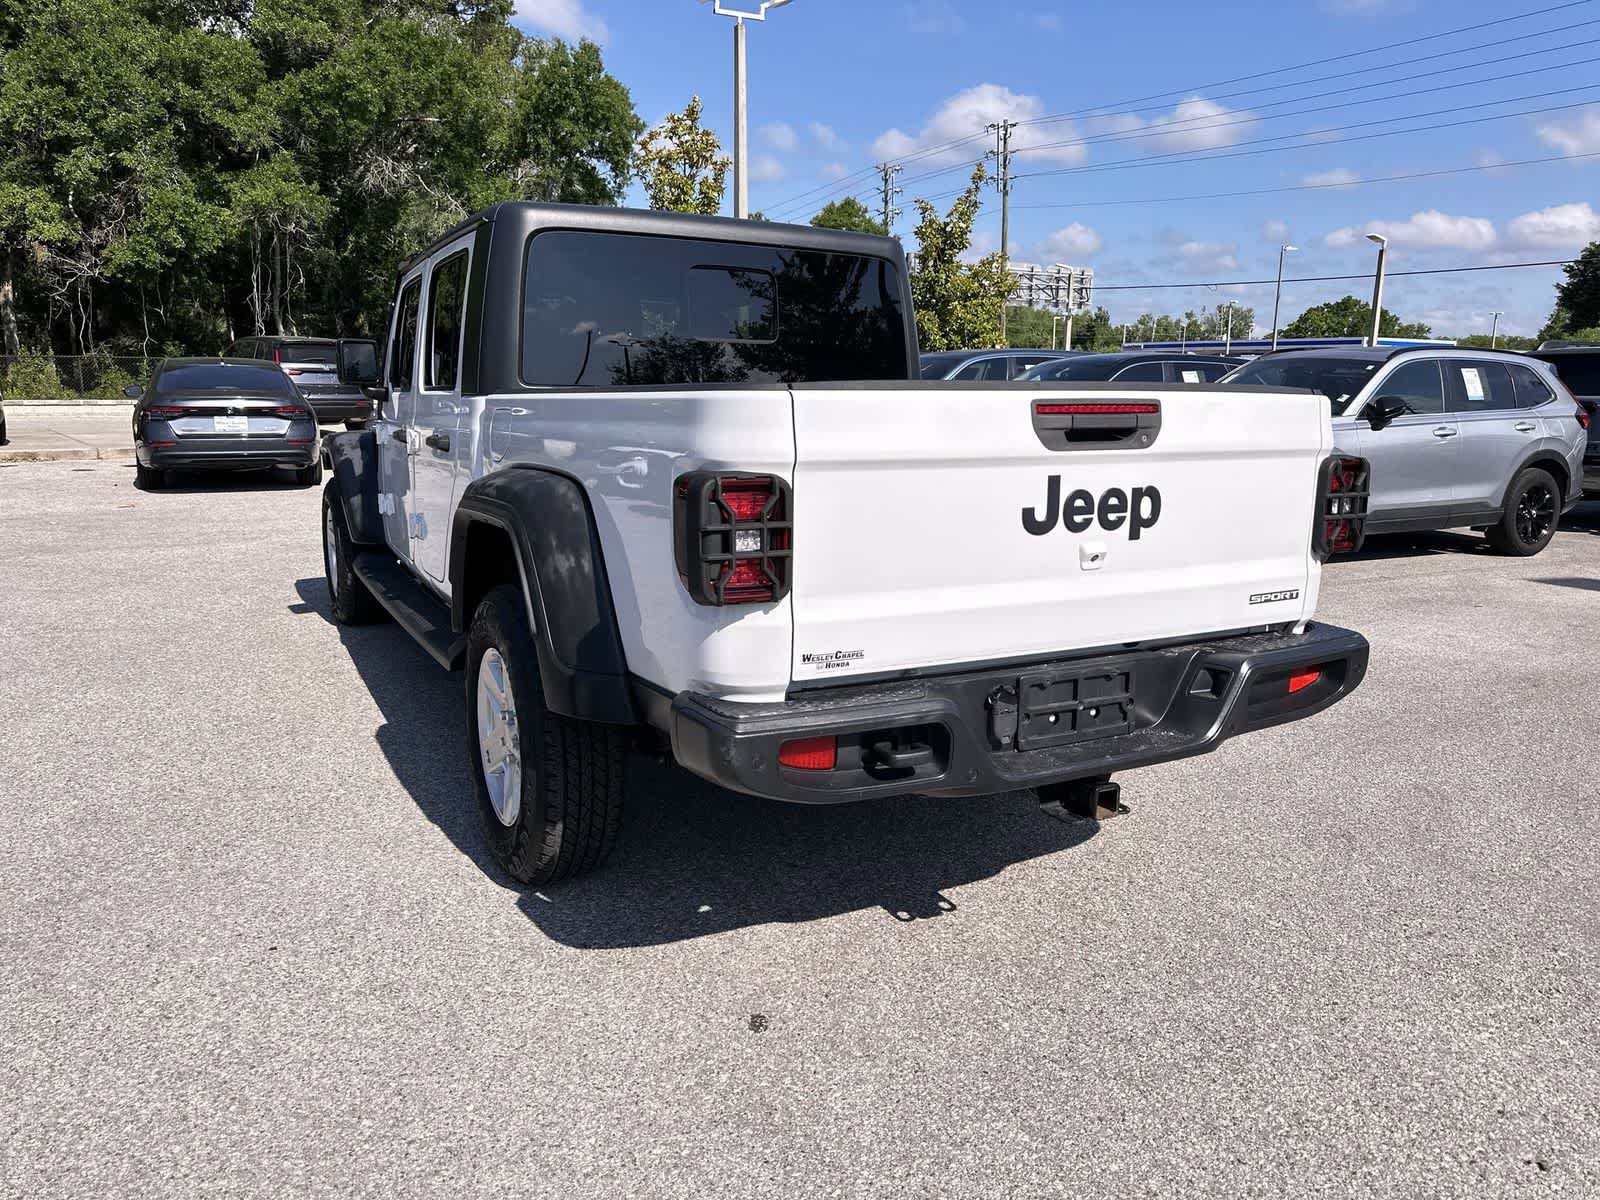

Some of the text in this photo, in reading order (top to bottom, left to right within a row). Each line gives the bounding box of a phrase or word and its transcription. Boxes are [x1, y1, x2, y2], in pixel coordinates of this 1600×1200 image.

[1022, 475, 1161, 540] Jeep
[1249, 589, 1299, 604] SPORT
[825, 661, 850, 669] HONDA
